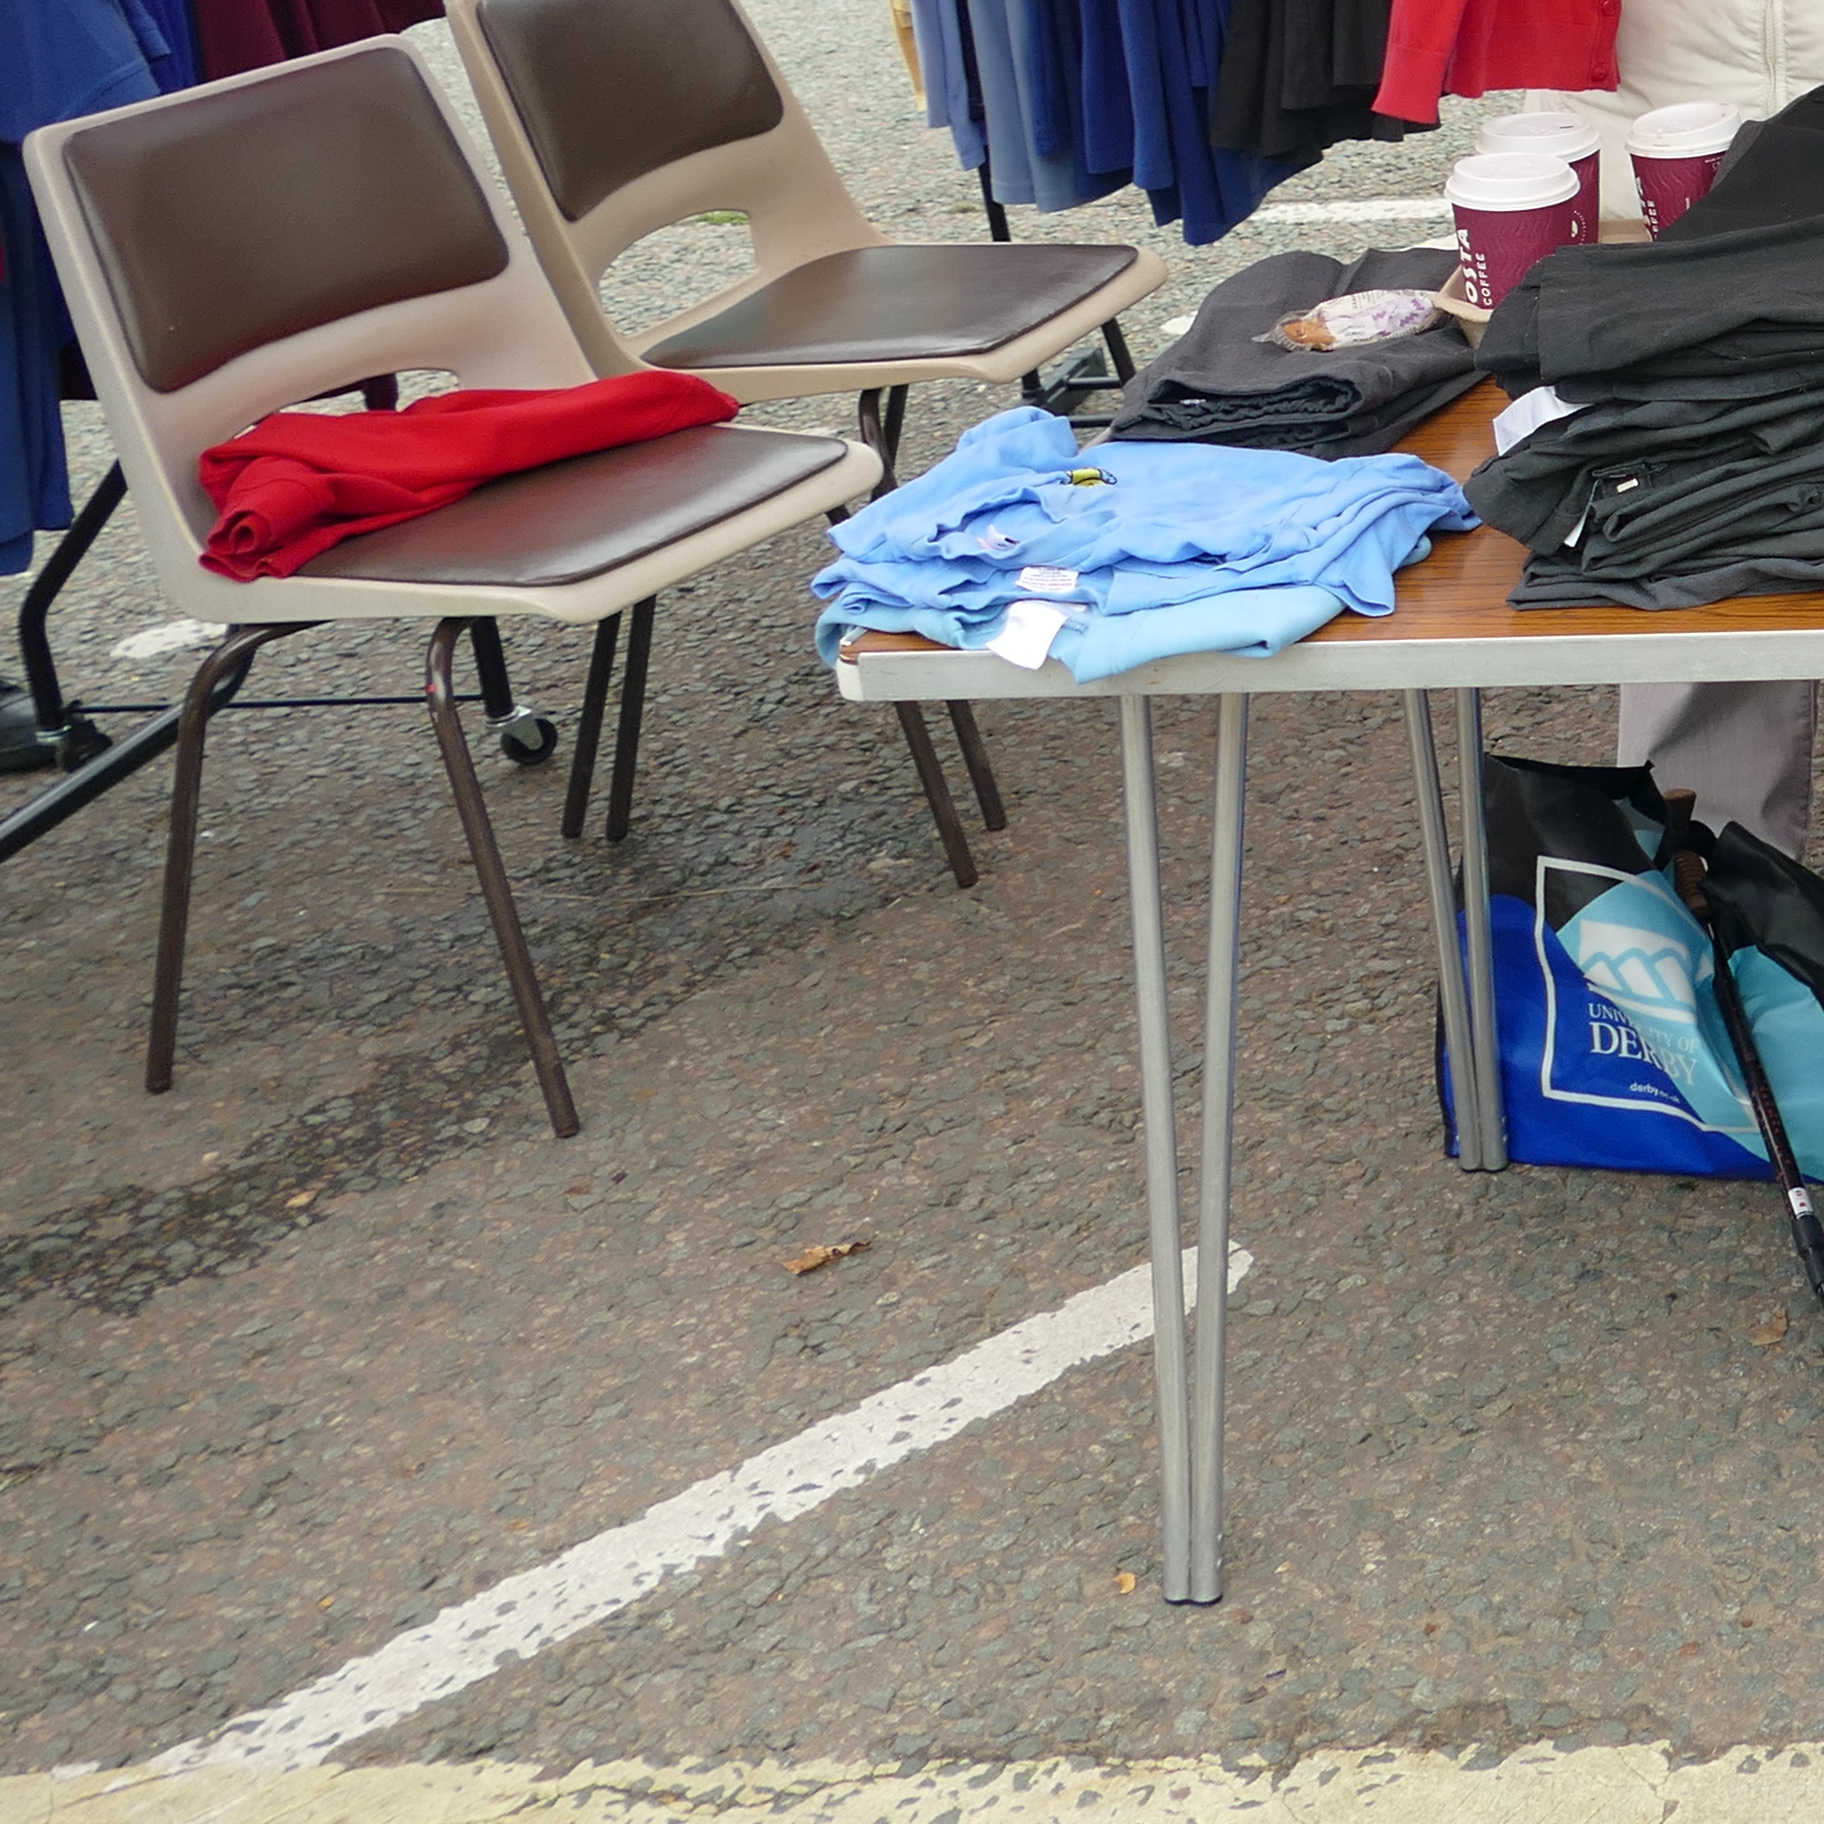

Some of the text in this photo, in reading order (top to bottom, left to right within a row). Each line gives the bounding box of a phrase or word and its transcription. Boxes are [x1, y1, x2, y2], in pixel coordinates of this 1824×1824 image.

[1456, 228, 1478, 304] OSTA
[1475, 253, 1493, 307] COFFEE
[1588, 1021, 1698, 1087] DERBY
